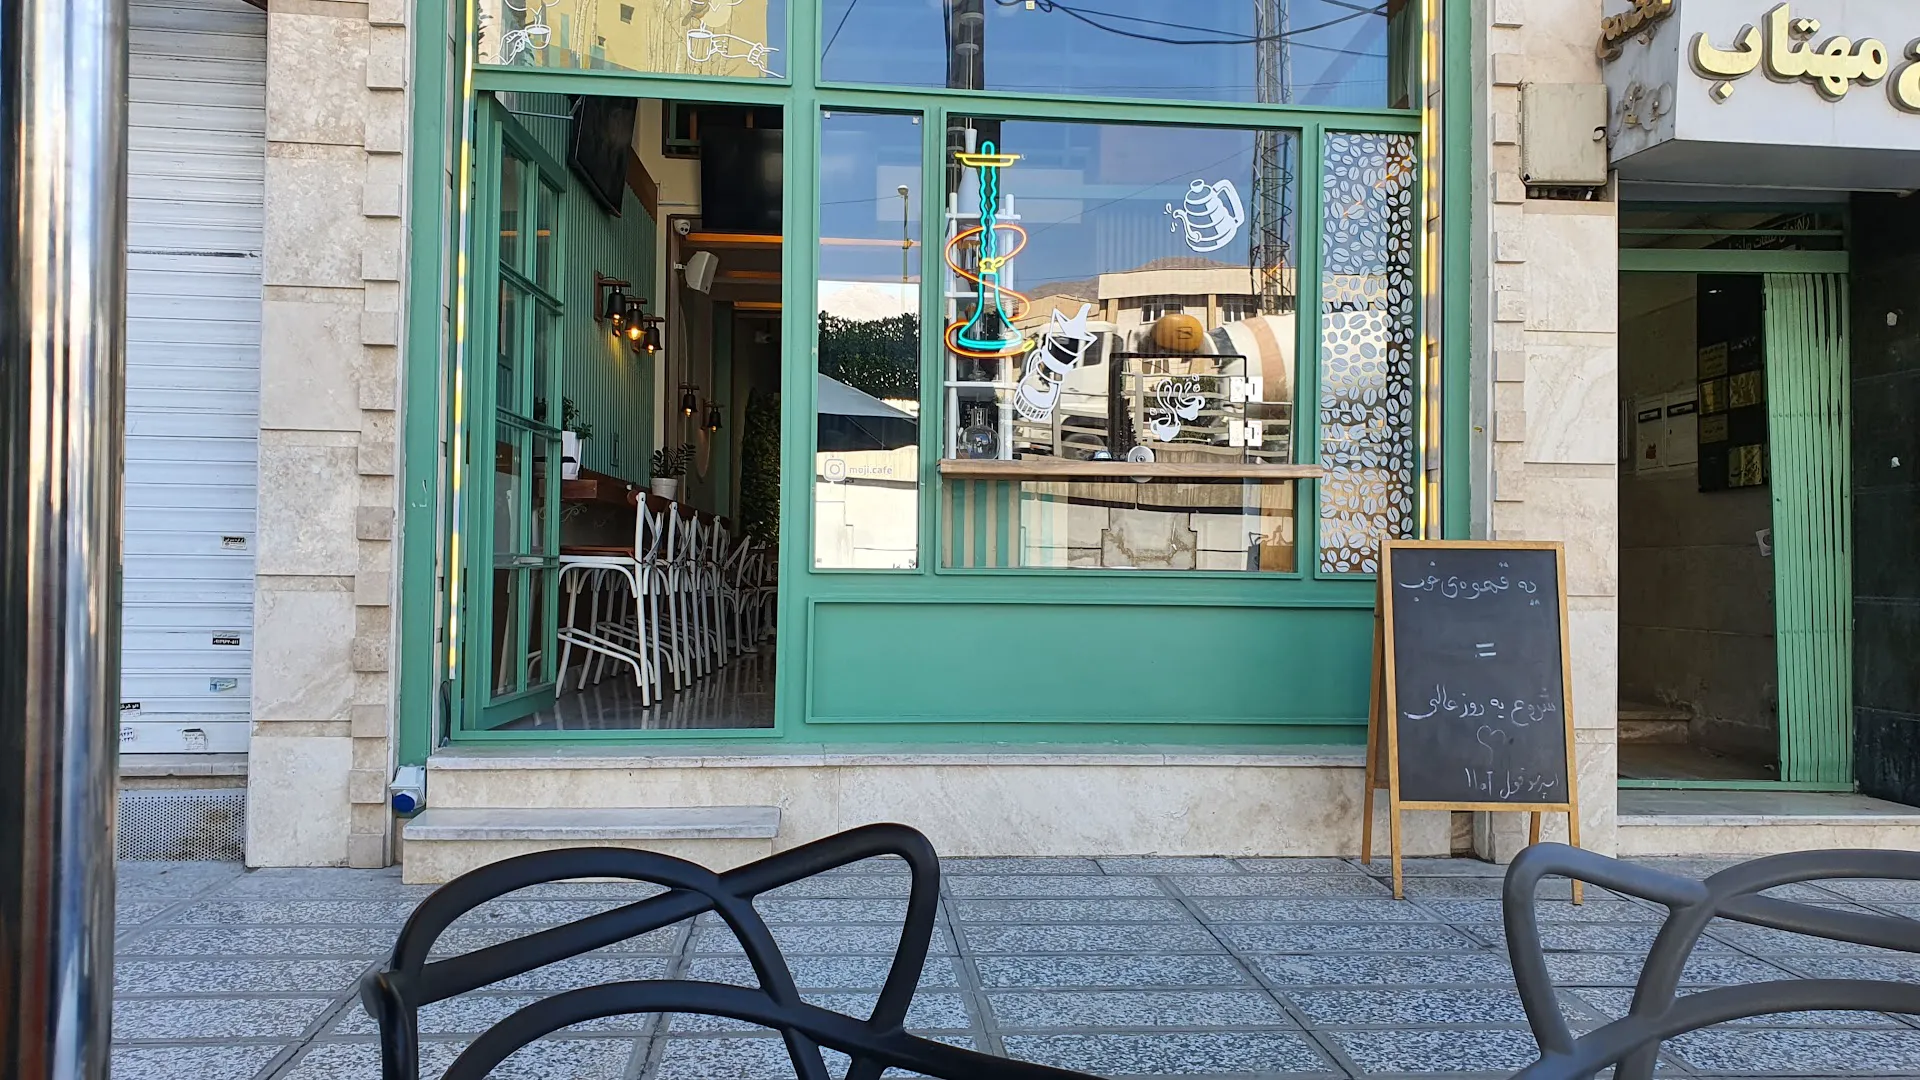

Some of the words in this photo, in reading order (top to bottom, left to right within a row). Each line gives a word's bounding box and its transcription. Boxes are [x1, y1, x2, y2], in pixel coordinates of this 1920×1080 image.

[1692, 2, 1888, 100] مهتاب
[849, 465, 893, 475] moji.cafe
[1403, 683, 1458, 720] عالی
[1458, 692, 1485, 719] روز
